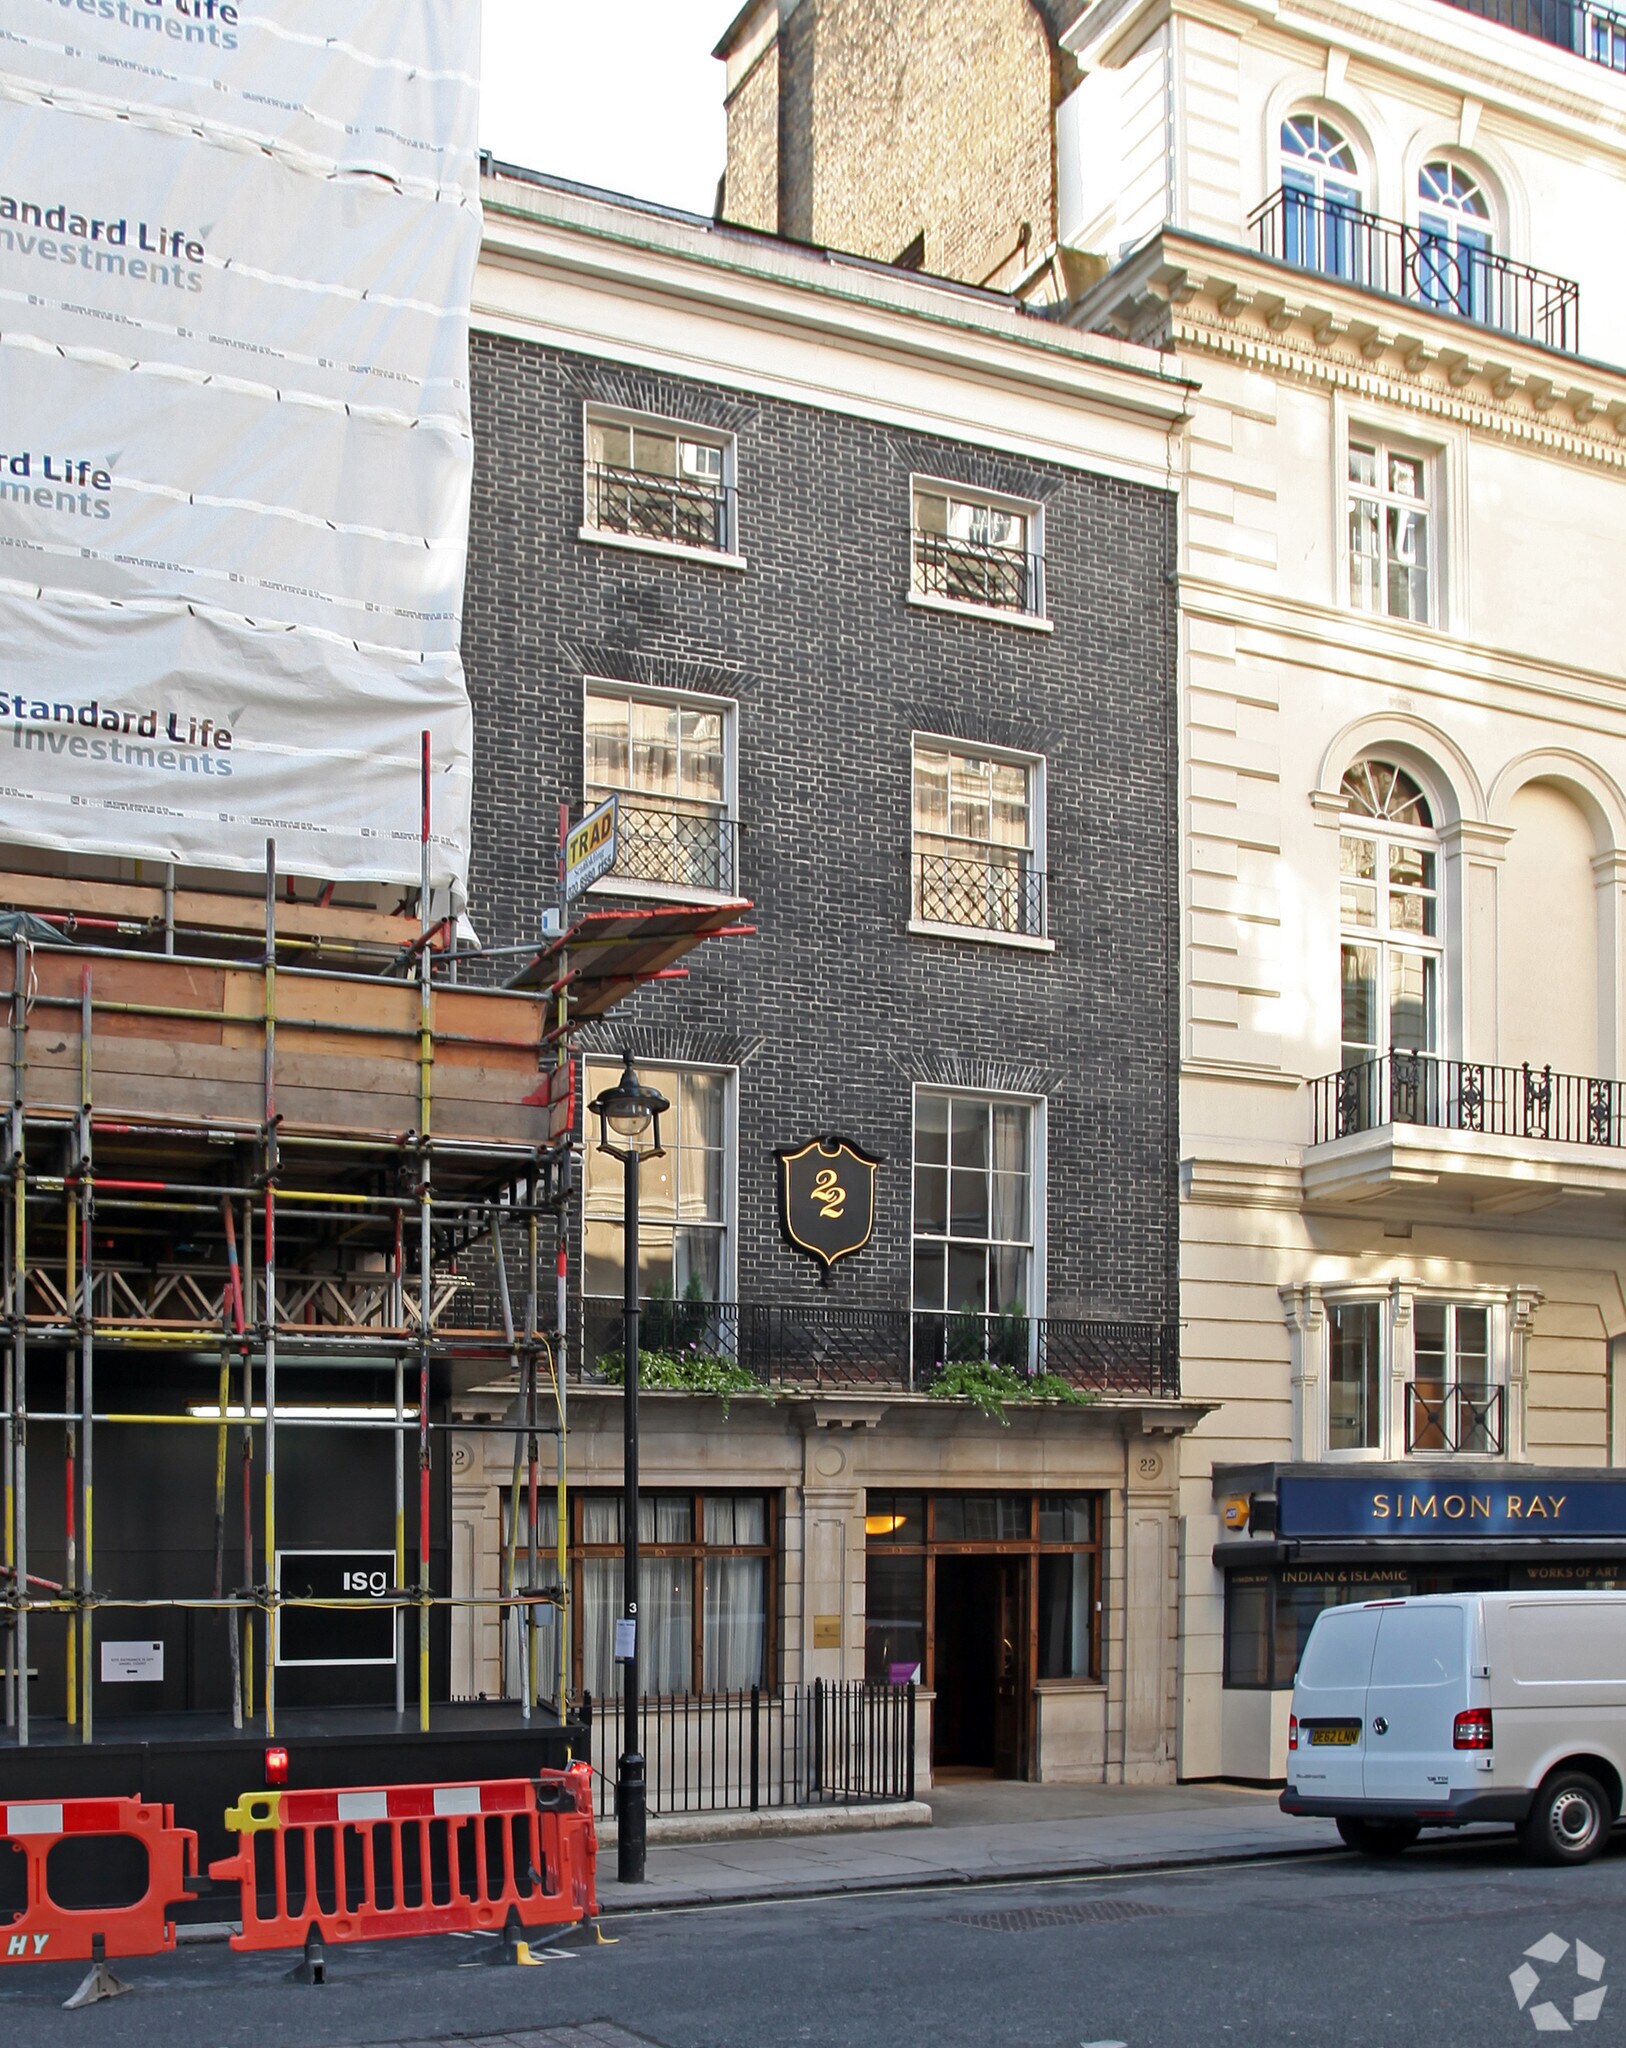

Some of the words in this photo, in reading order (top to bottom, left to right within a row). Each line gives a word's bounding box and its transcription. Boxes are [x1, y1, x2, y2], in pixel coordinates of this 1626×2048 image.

[138, 222, 204, 263] Life
[43, 454, 111, 491] Life
[166, 711, 233, 750] Life
[13, 720, 233, 776] Investments
[570, 813, 612, 863] TRAD
[1140, 1458, 1156, 1472] 22
[1373, 1494, 1491, 1518] SIMON
[1507, 1495, 1567, 1518] RAY
[1282, 1571, 1335, 1582] INDIAN
[1337, 1571, 1347, 1582] &
[1350, 1570, 1408, 1582] ISLAMIC
[1527, 1567, 1573, 1578] WORKS
[1576, 1567, 1591, 1577] OF
[1595, 1566, 1618, 1577] ART
[629, 1602, 638, 1613] 3
